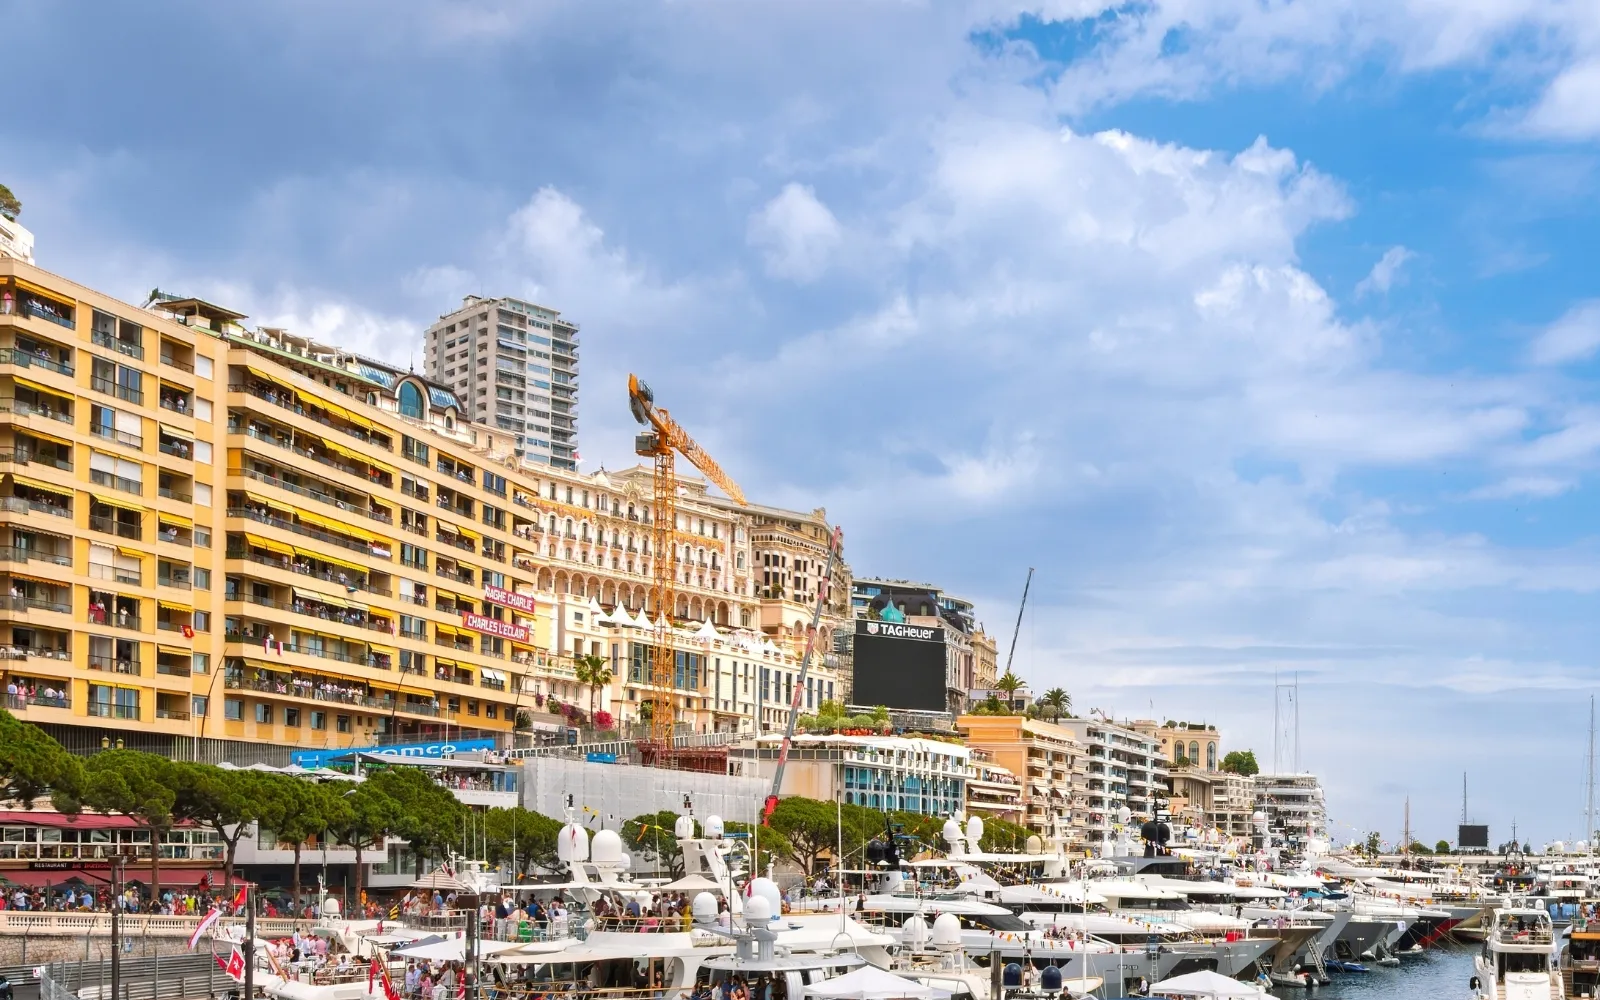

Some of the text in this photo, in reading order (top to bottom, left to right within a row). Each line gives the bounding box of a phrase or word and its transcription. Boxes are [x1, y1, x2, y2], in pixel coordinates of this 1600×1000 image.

[507, 593, 533, 610] CHARLIE
[467, 615, 525, 640] CHARLES L'ECLAIR
